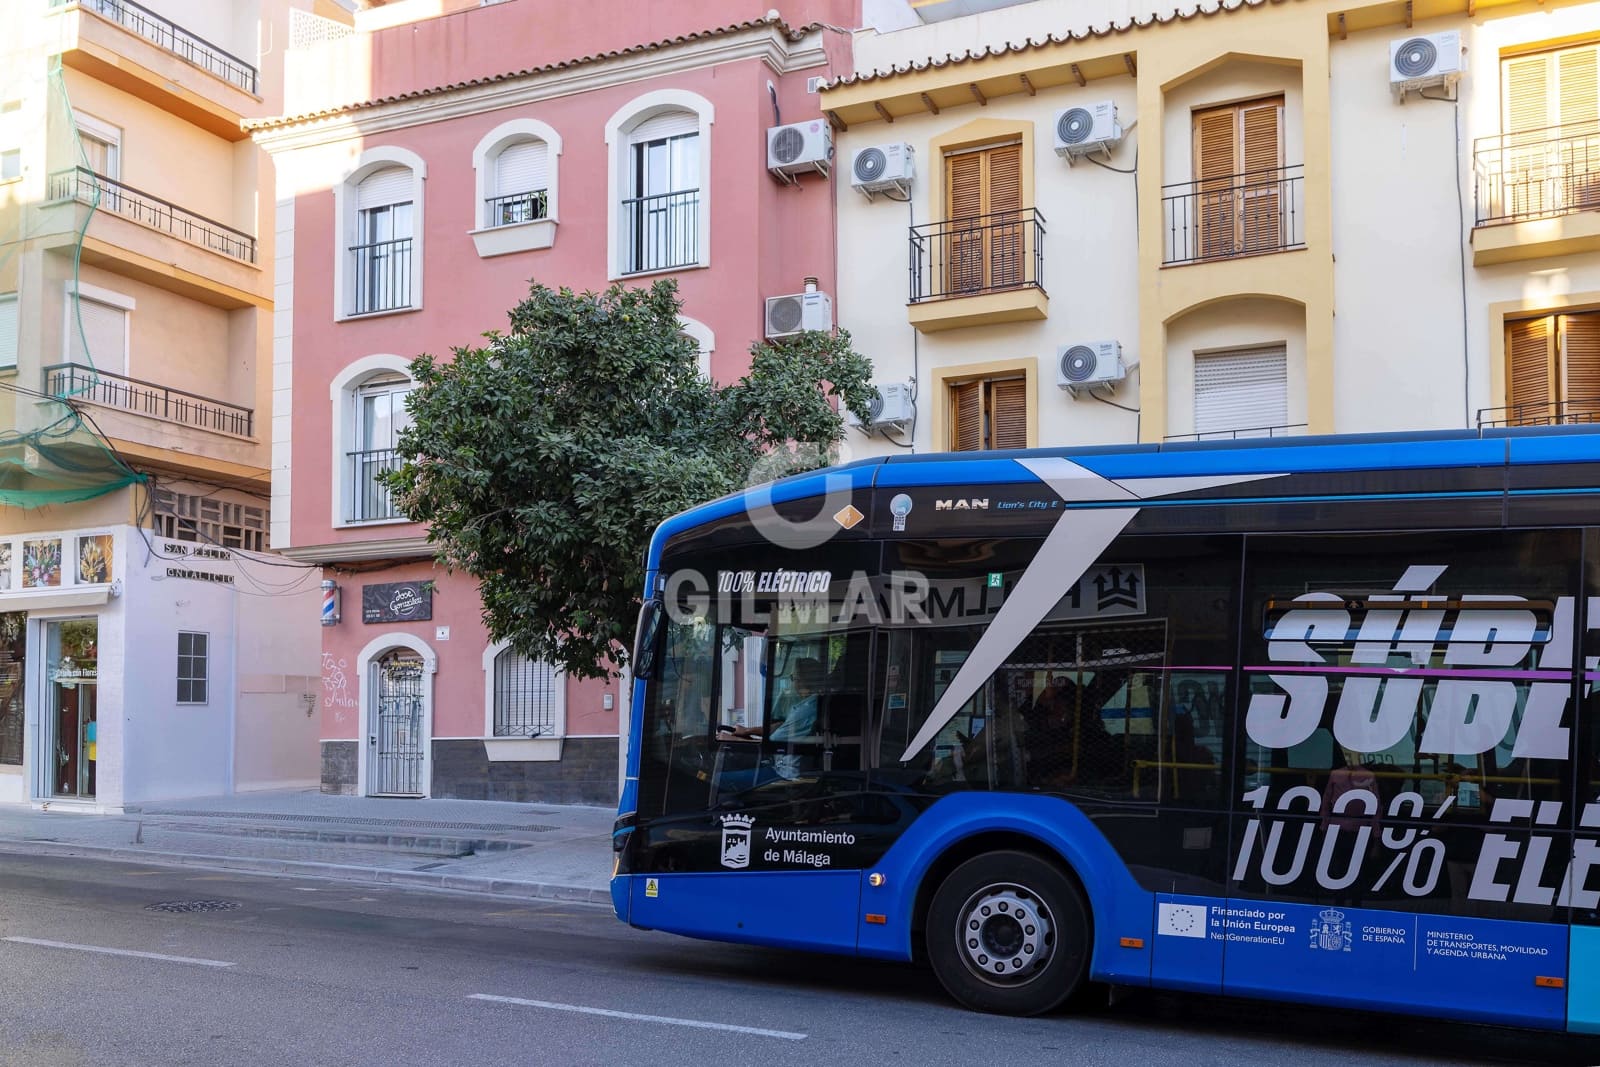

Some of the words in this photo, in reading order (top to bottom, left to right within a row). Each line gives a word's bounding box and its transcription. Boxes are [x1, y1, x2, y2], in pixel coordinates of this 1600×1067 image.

[935, 498, 989, 511] MAN
[997, 501, 1025, 509] Lion's
[1028, 501, 1048, 509] City
[1051, 500, 1059, 508] E
[164, 543, 188, 555] SAN
[193, 546, 231, 560] FELIX
[717, 570, 755, 593] 100%
[756, 567, 832, 593] ELÉCTRICO
[765, 827, 855, 845] Ayuntamiento
[1232, 785, 1456, 897] 100%
[764, 848, 780, 861] de
[783, 850, 831, 867] Málaga
[1211, 906, 1265, 919] Financiado
[1268, 912, 1285, 921] por
[1211, 918, 1220, 927] la
[1222, 919, 1251, 930] Unión
[1254, 921, 1296, 934] Europea
[1362, 926, 1406, 936] GOBIERNO
[1210, 932, 1285, 945] NextGenerationEU
[1375, 935, 1405, 944] ESPAÑA
[1427, 930, 1474, 941] MINISTERIO
[1427, 939, 1438, 947] DE
[1439, 940, 1499, 952] TRANSPORTES,
[1500, 945, 1548, 956] MOVILIDAD
[1433, 948, 1469, 958] AGENDA
[1471, 951, 1507, 960] URBANA
